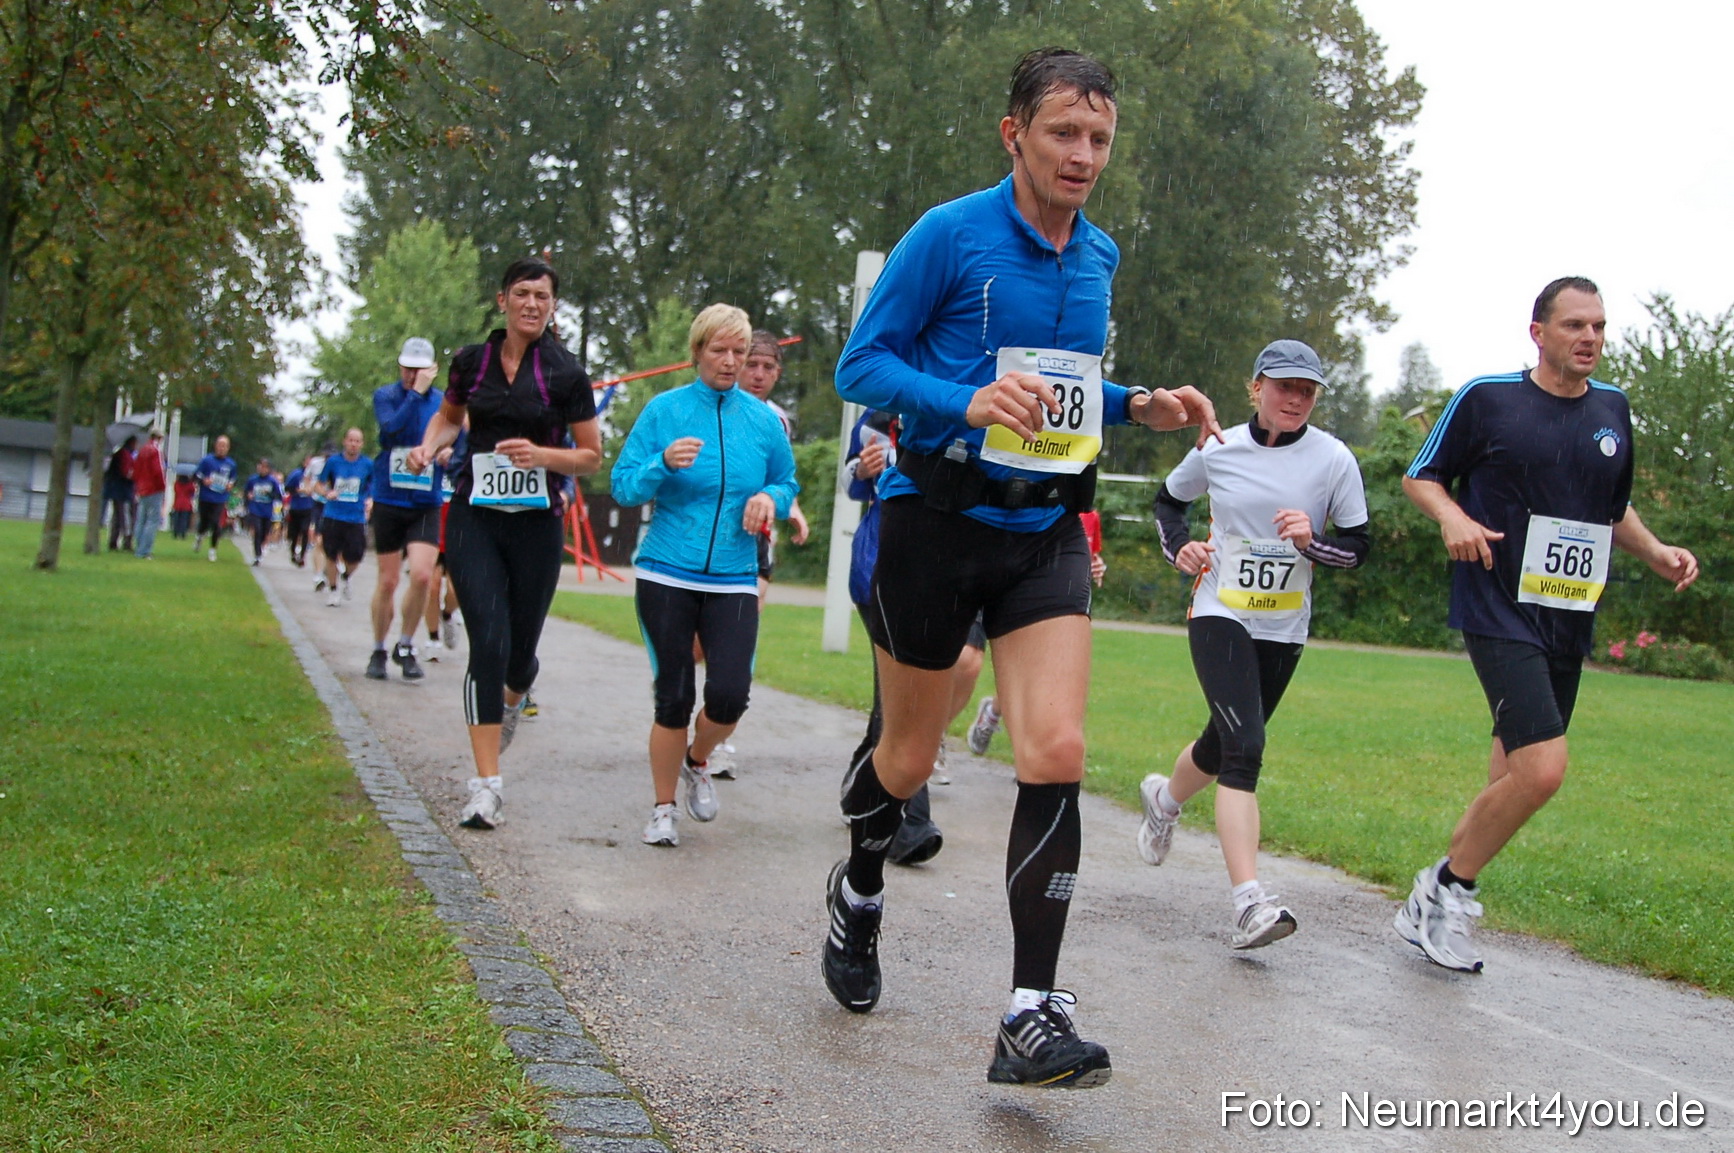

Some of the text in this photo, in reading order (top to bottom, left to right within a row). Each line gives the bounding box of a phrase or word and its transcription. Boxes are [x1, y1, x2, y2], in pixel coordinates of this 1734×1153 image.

[1038, 357, 1076, 371] BOCK
[1035, 383, 1085, 430] 88
[482, 470, 539, 496] 3006
[1545, 542, 1593, 578] 568
[1239, 559, 1296, 590] 567
[1247, 596, 1277, 609] Anita
[1540, 580, 1587, 600] Wolfgang
